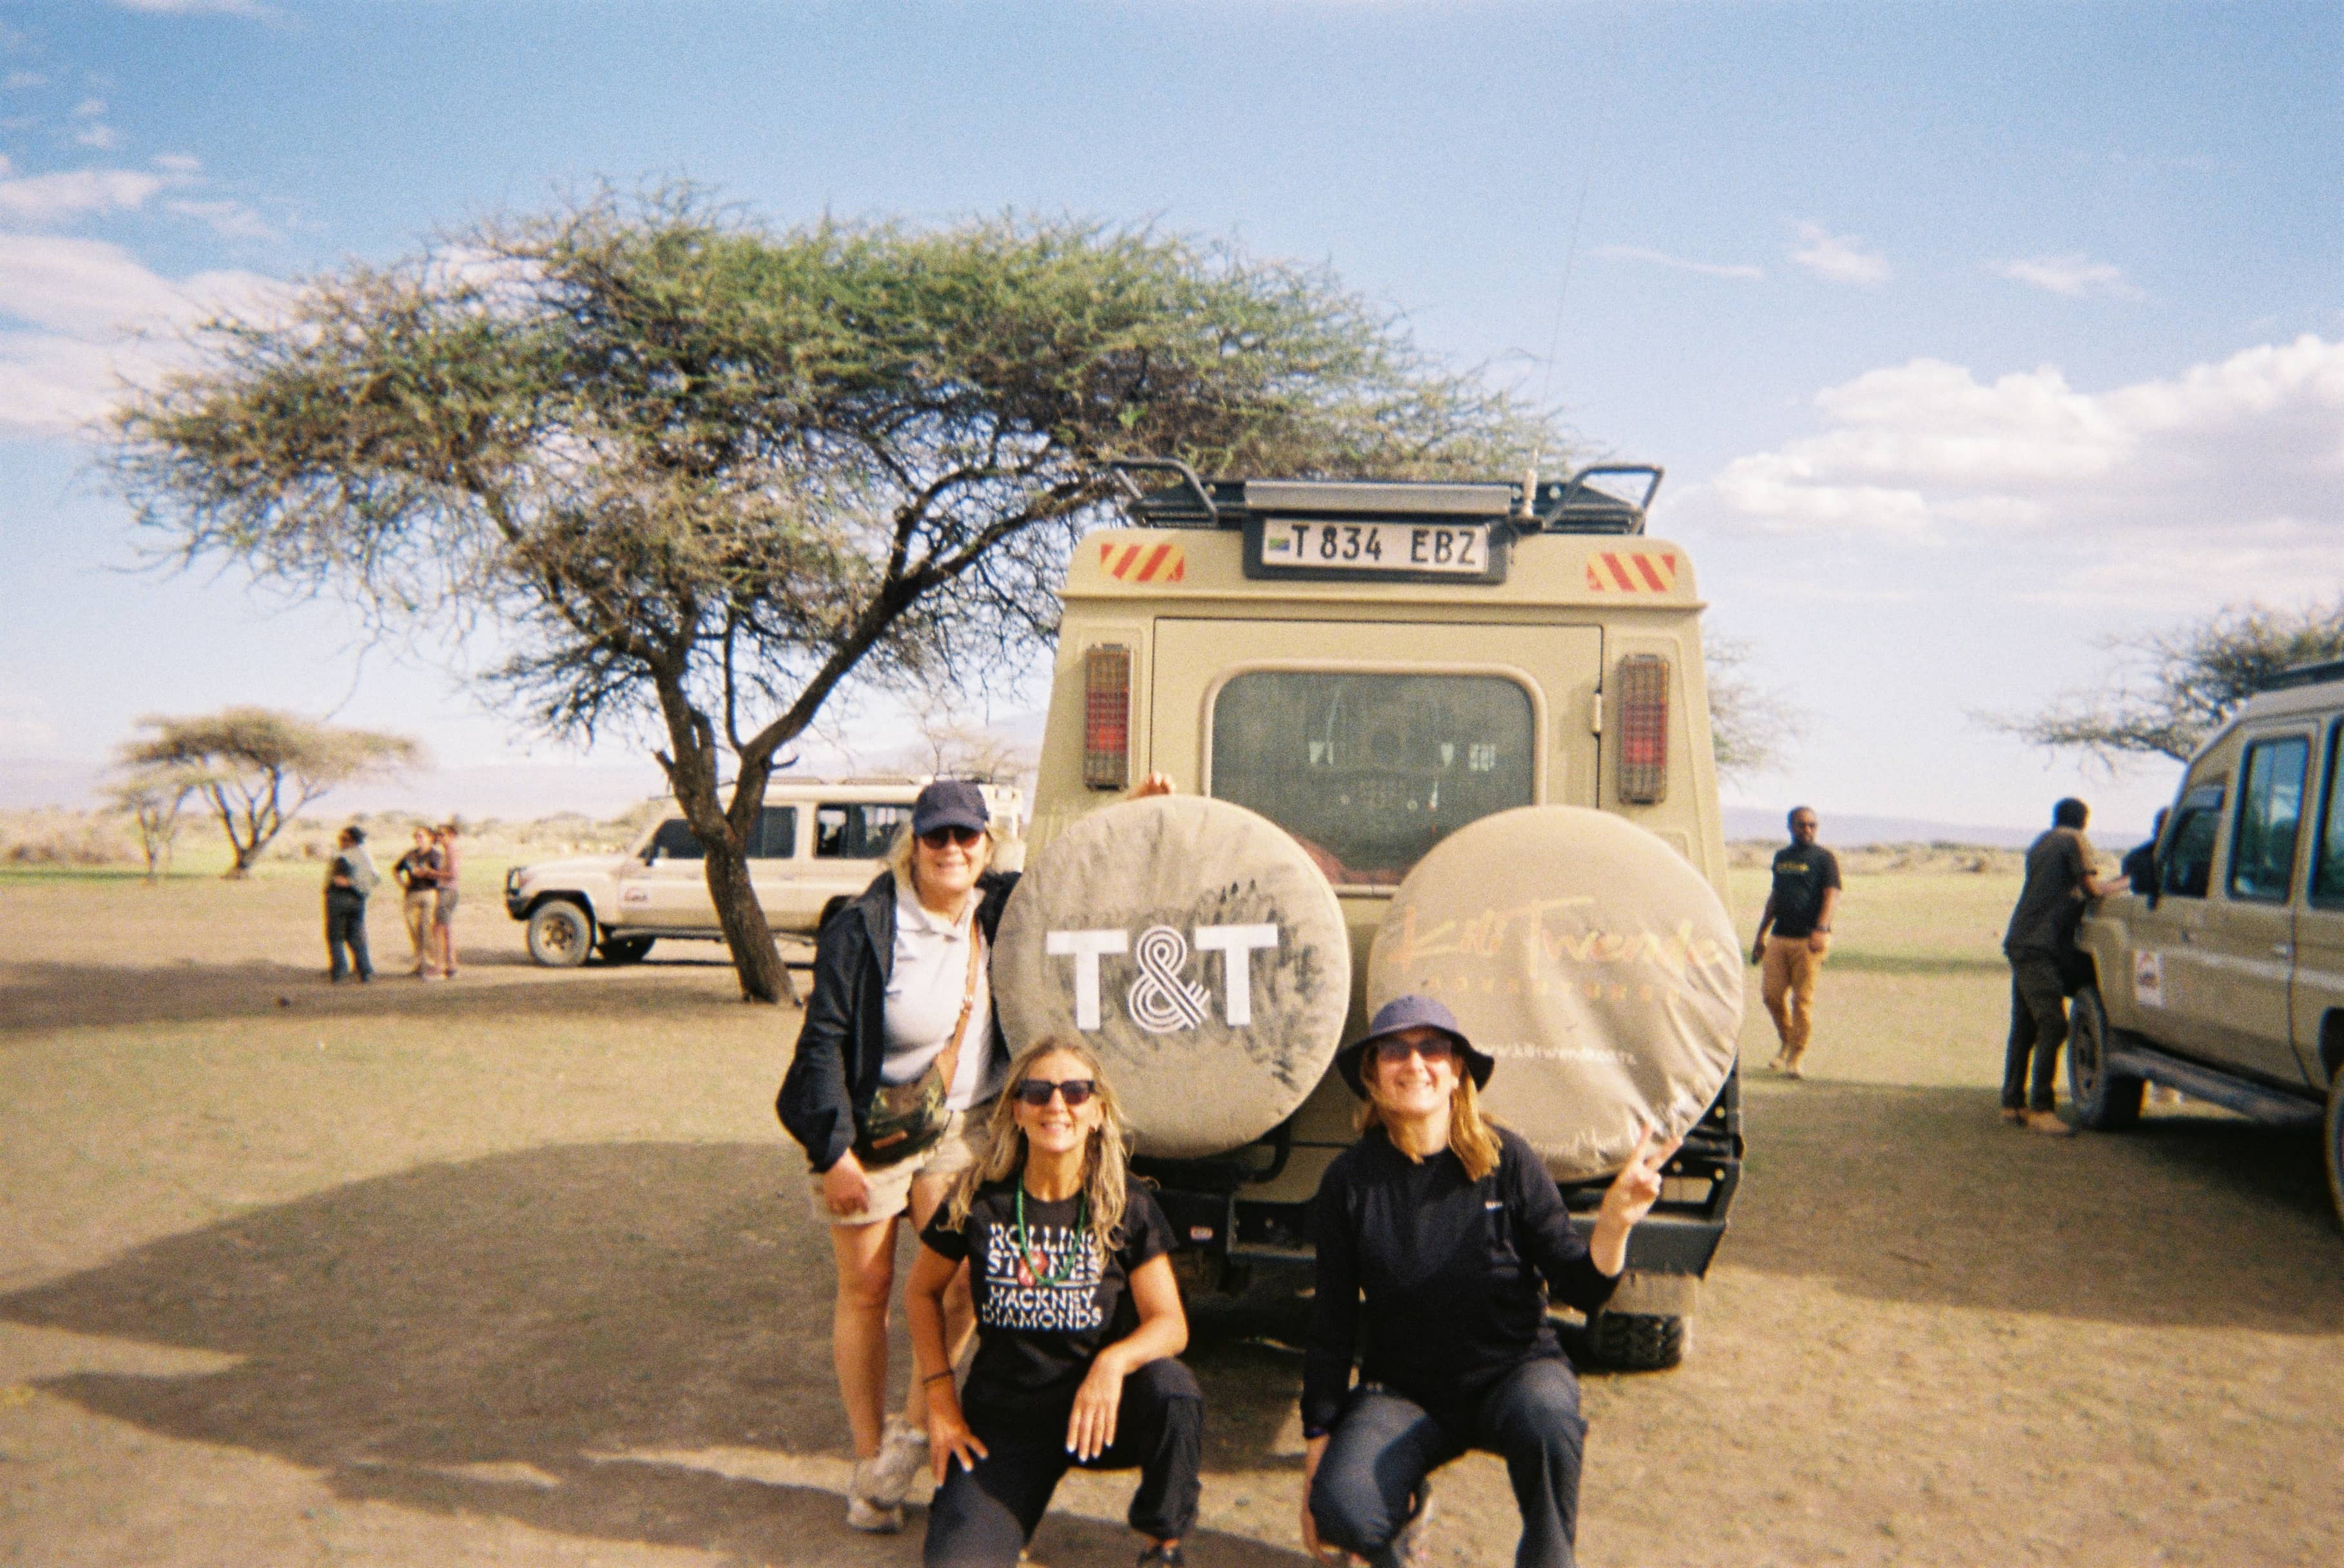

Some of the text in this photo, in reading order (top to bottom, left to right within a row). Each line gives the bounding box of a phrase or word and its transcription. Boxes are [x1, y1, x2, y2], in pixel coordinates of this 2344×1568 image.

[1291, 524, 1477, 565] T 834 EBZ
[1046, 923, 1279, 1033] T&T
[990, 1285, 1096, 1311] HACKNEY
[982, 1302, 1103, 1330] DIAMONDS
